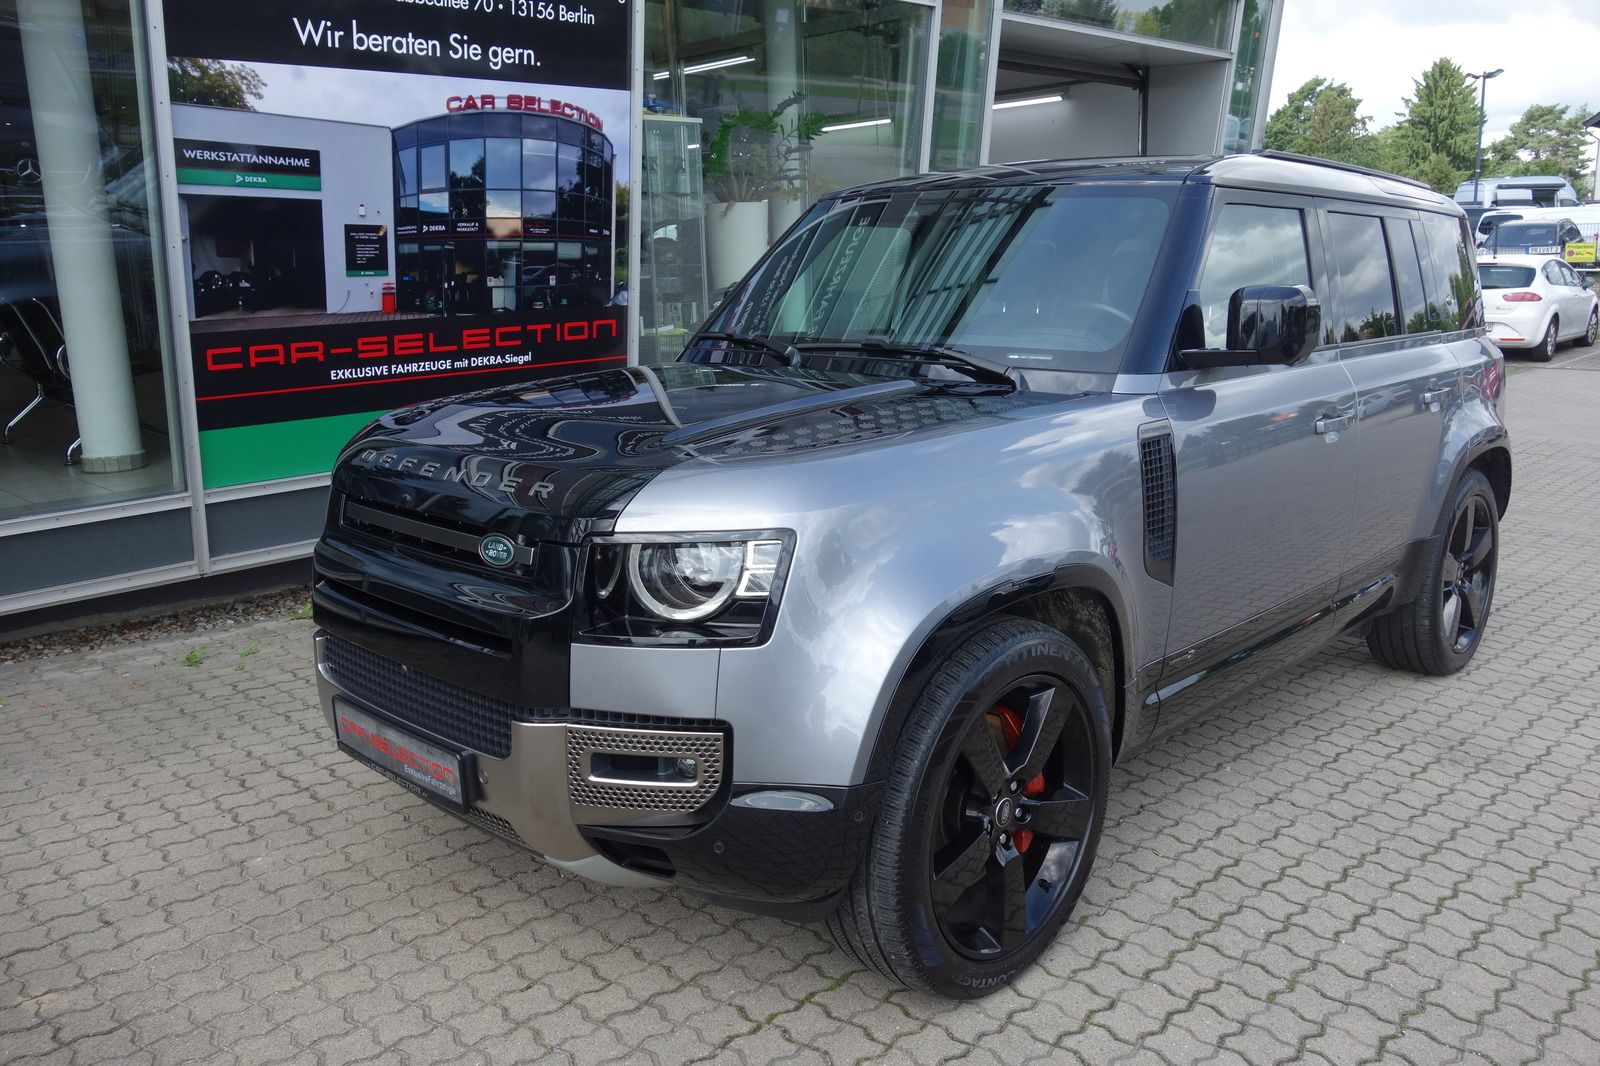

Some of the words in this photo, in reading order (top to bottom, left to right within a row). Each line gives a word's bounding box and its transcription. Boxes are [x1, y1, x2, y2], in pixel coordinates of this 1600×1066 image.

[474, 0, 494, 13] 70
[510, 0, 555, 20] 13156
[558, 4, 596, 25] Berlin
[292, 16, 345, 48] Wir
[351, 19, 442, 57] beraten
[449, 32, 483, 61] Sie
[488, 45, 542, 70] gern.
[446, 94, 496, 113] CAR
[506, 94, 604, 131] SELECTION
[182, 148, 311, 168] WERKSTATTANNAHME
[244, 175, 268, 184] DEKRA
[428, 224, 446, 232] DEKRA
[206, 319, 617, 372] CAR-SELECTION
[330, 364, 389, 381] EXKLUSIVE
[391, 359, 452, 375] FAHRZEUGE
[453, 357, 469, 369] mit
[470, 351, 532, 367] DEKRA-Siegel
[359, 448, 555, 499] DEFENDER
